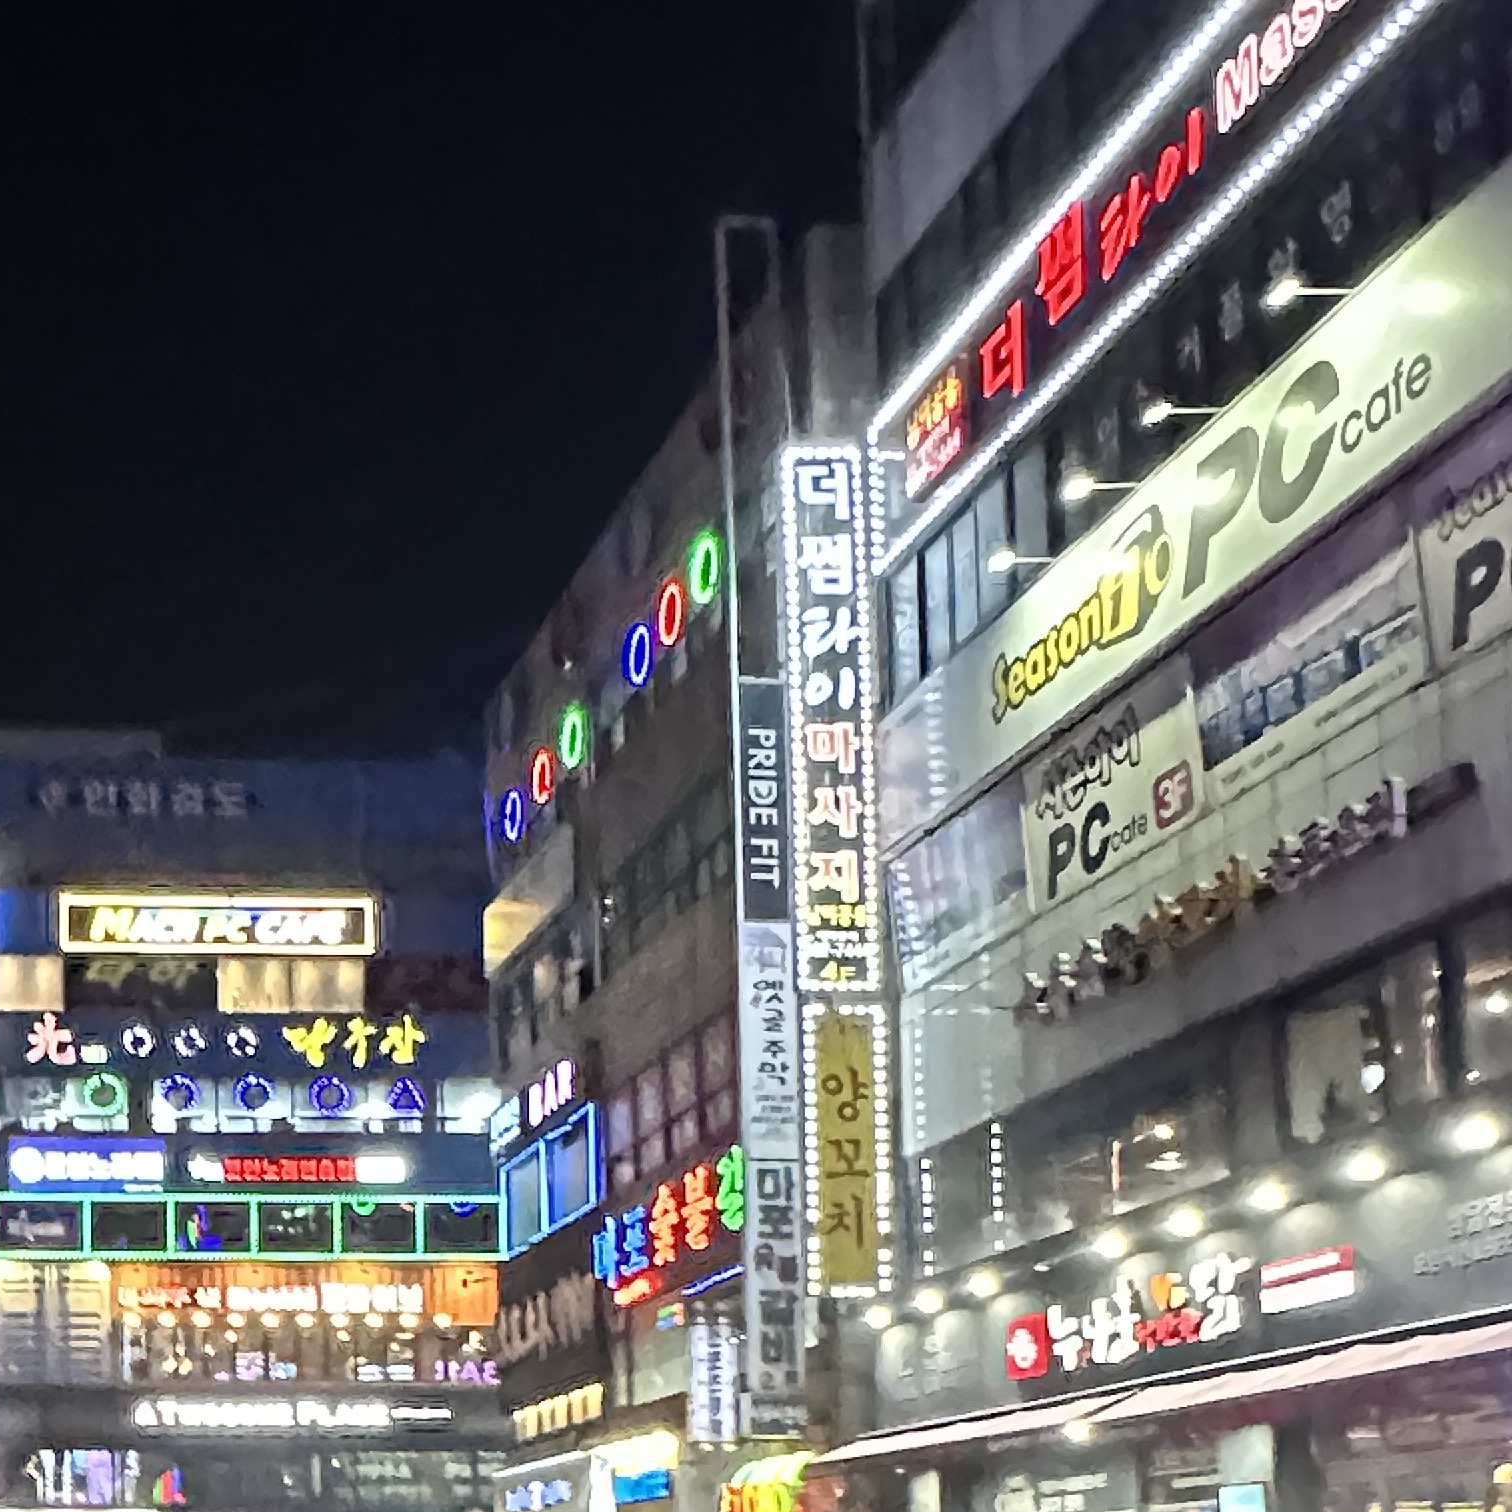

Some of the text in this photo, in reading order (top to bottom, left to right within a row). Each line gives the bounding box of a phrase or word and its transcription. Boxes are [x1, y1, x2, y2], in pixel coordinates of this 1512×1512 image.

[1182, 360, 1341, 600] PC
[1338, 352, 1433, 454] cafe
[747, 728, 780, 890] PRIDE FIT
[803, 720, 863, 904] 마사지
[1048, 801, 1149, 900] PC cafe
[1159, 769, 1189, 819] 3F
[820, 1064, 871, 1249] 양꼬치
